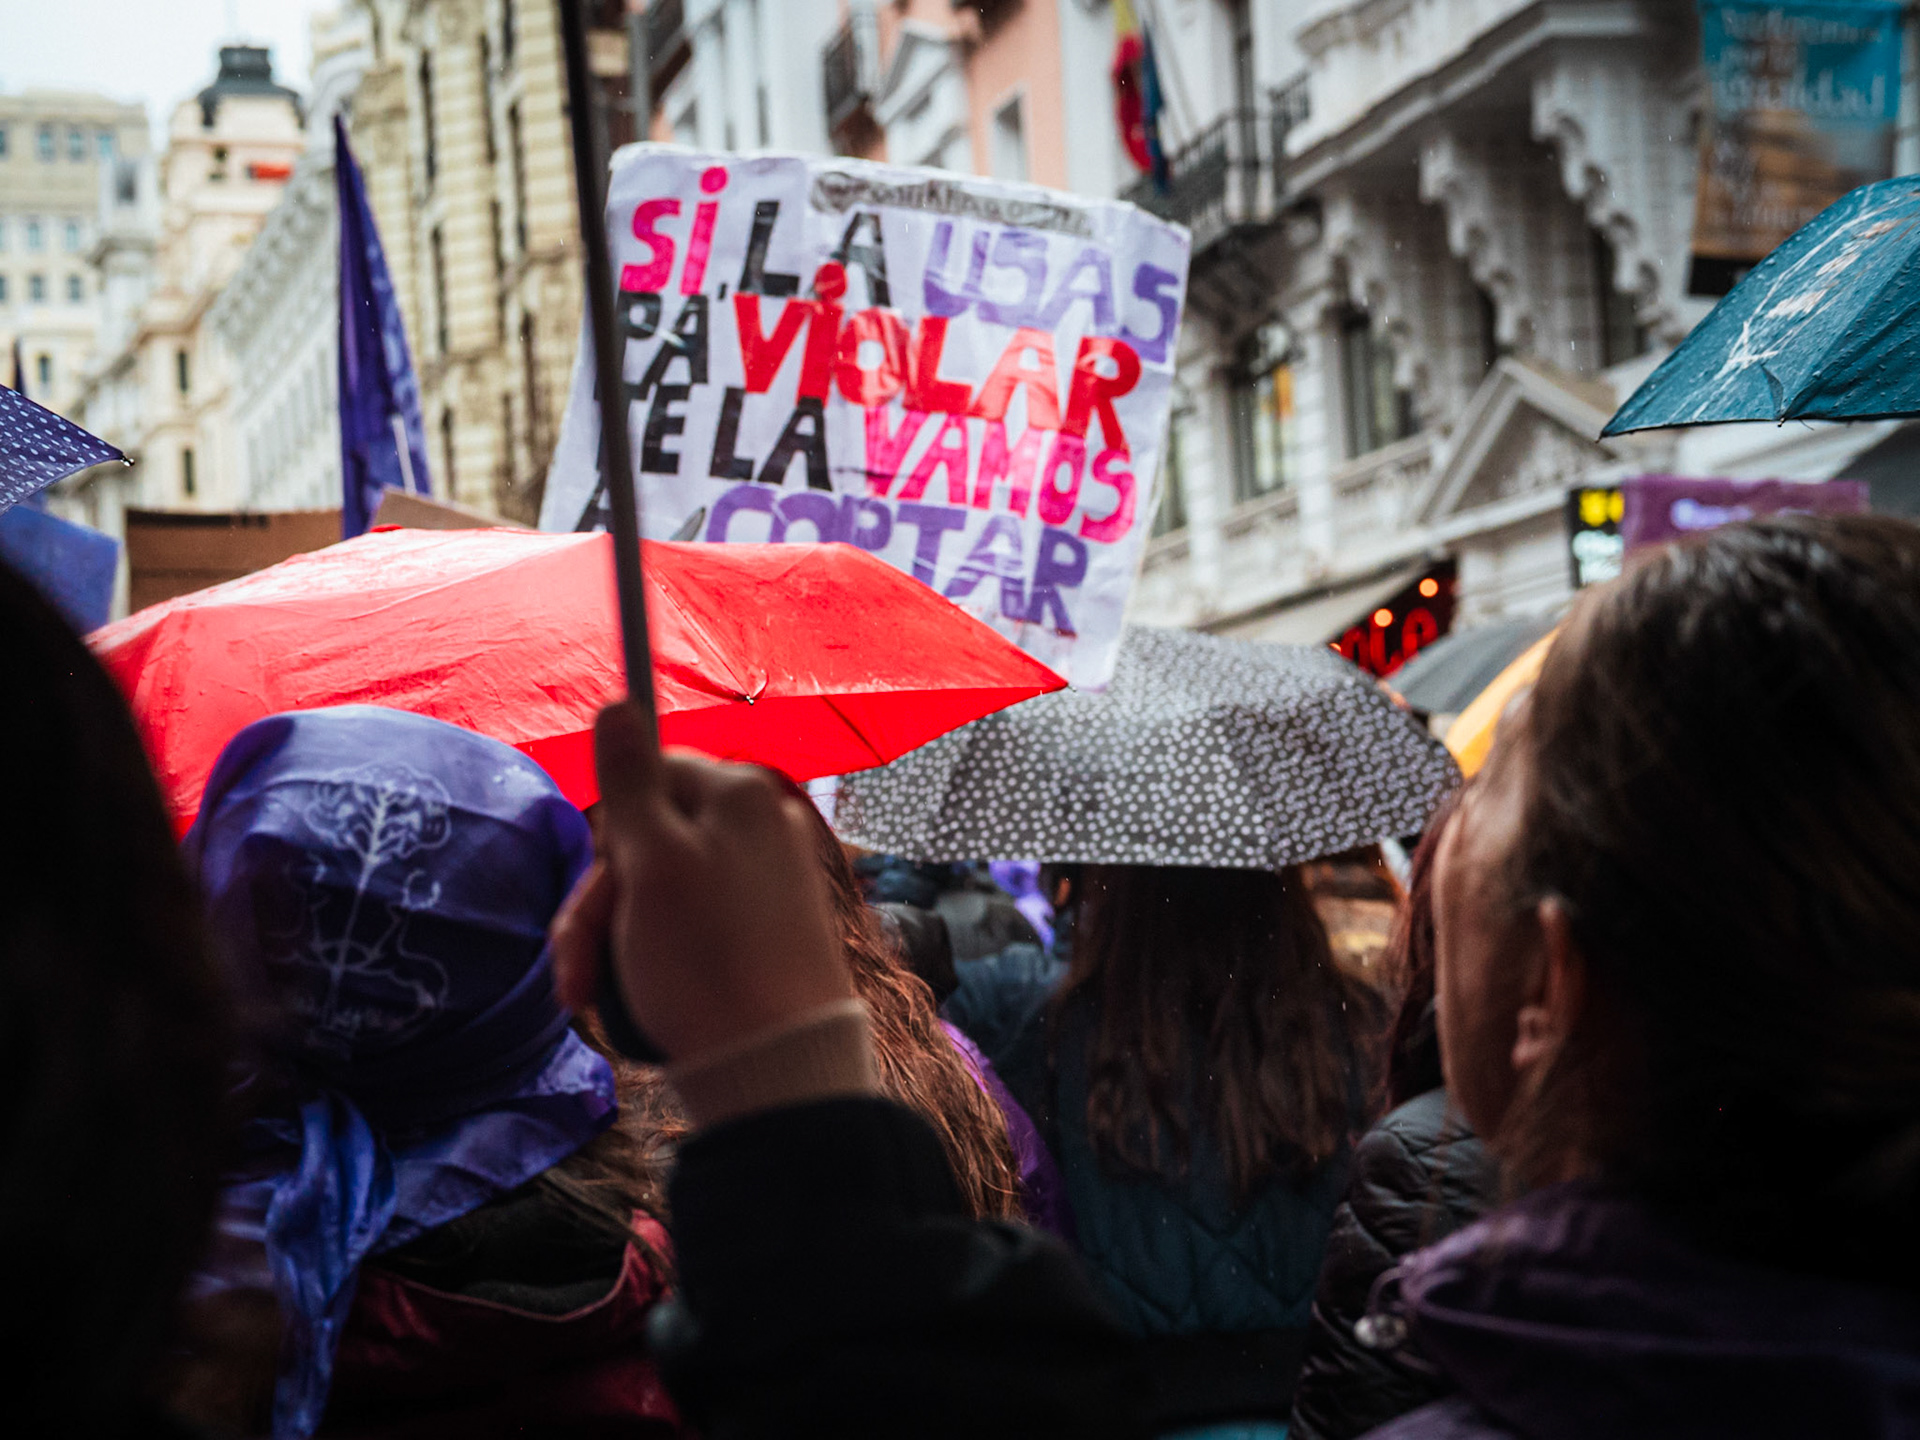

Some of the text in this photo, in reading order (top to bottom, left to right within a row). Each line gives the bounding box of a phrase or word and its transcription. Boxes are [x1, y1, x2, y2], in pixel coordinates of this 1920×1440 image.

[616, 290, 709, 394] PA
[738, 200, 892, 308] LA
[923, 221, 1179, 363] USAS
[711, 386, 832, 492] LA
[863, 405, 1137, 543] VAMOS
